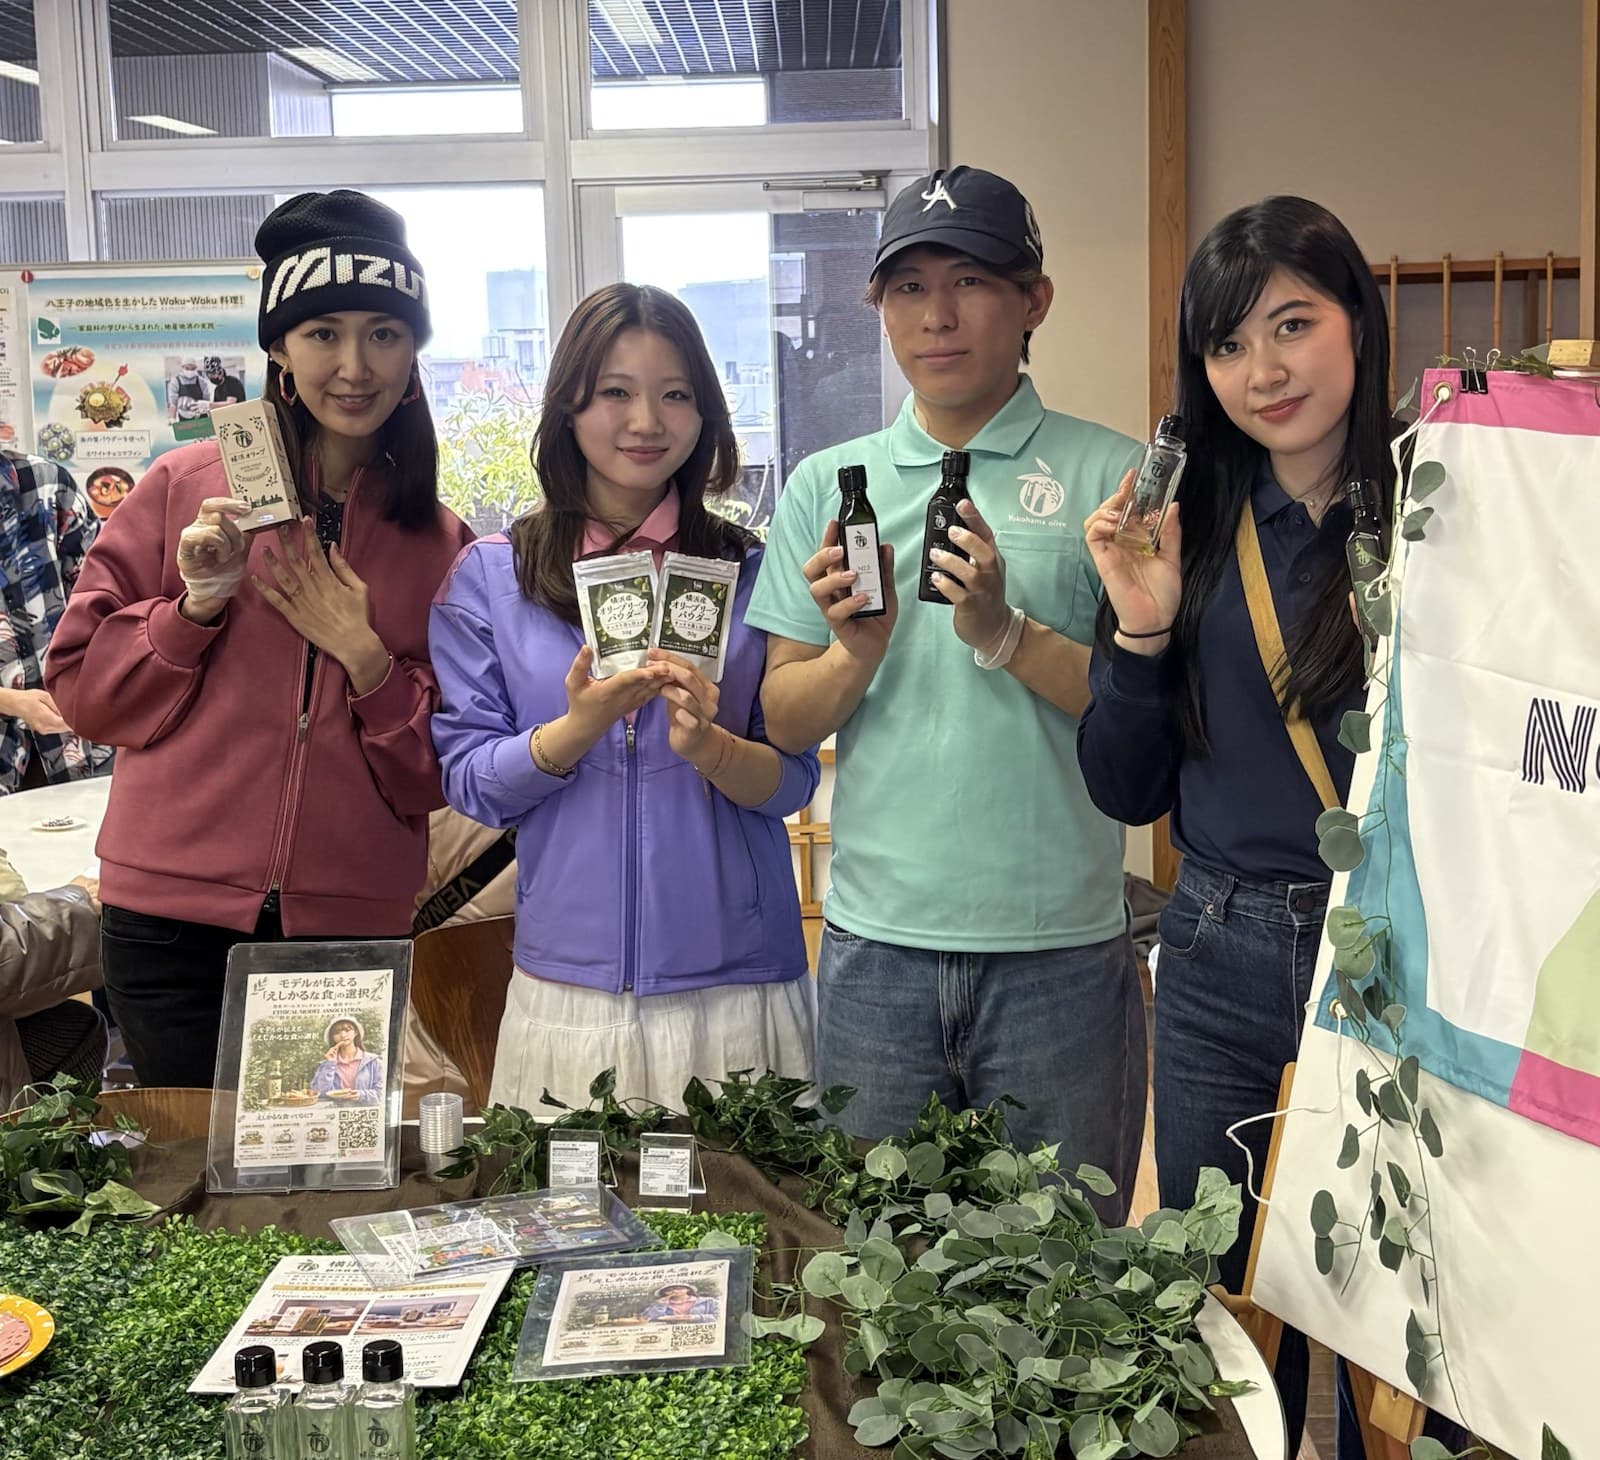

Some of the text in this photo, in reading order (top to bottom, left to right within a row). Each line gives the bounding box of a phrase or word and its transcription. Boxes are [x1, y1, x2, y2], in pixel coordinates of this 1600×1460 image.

[159, 295, 217, 306] Waku-Waku
[1008, 514, 1046, 526] Yokohama
[607, 609, 641, 622] パウダー
[677, 610, 711, 622] パウダー
[1521, 697, 1600, 794] N
[279, 976, 358, 989] モデルが伝える
[263, 988, 370, 1001] 「えしかるな食」の選択
